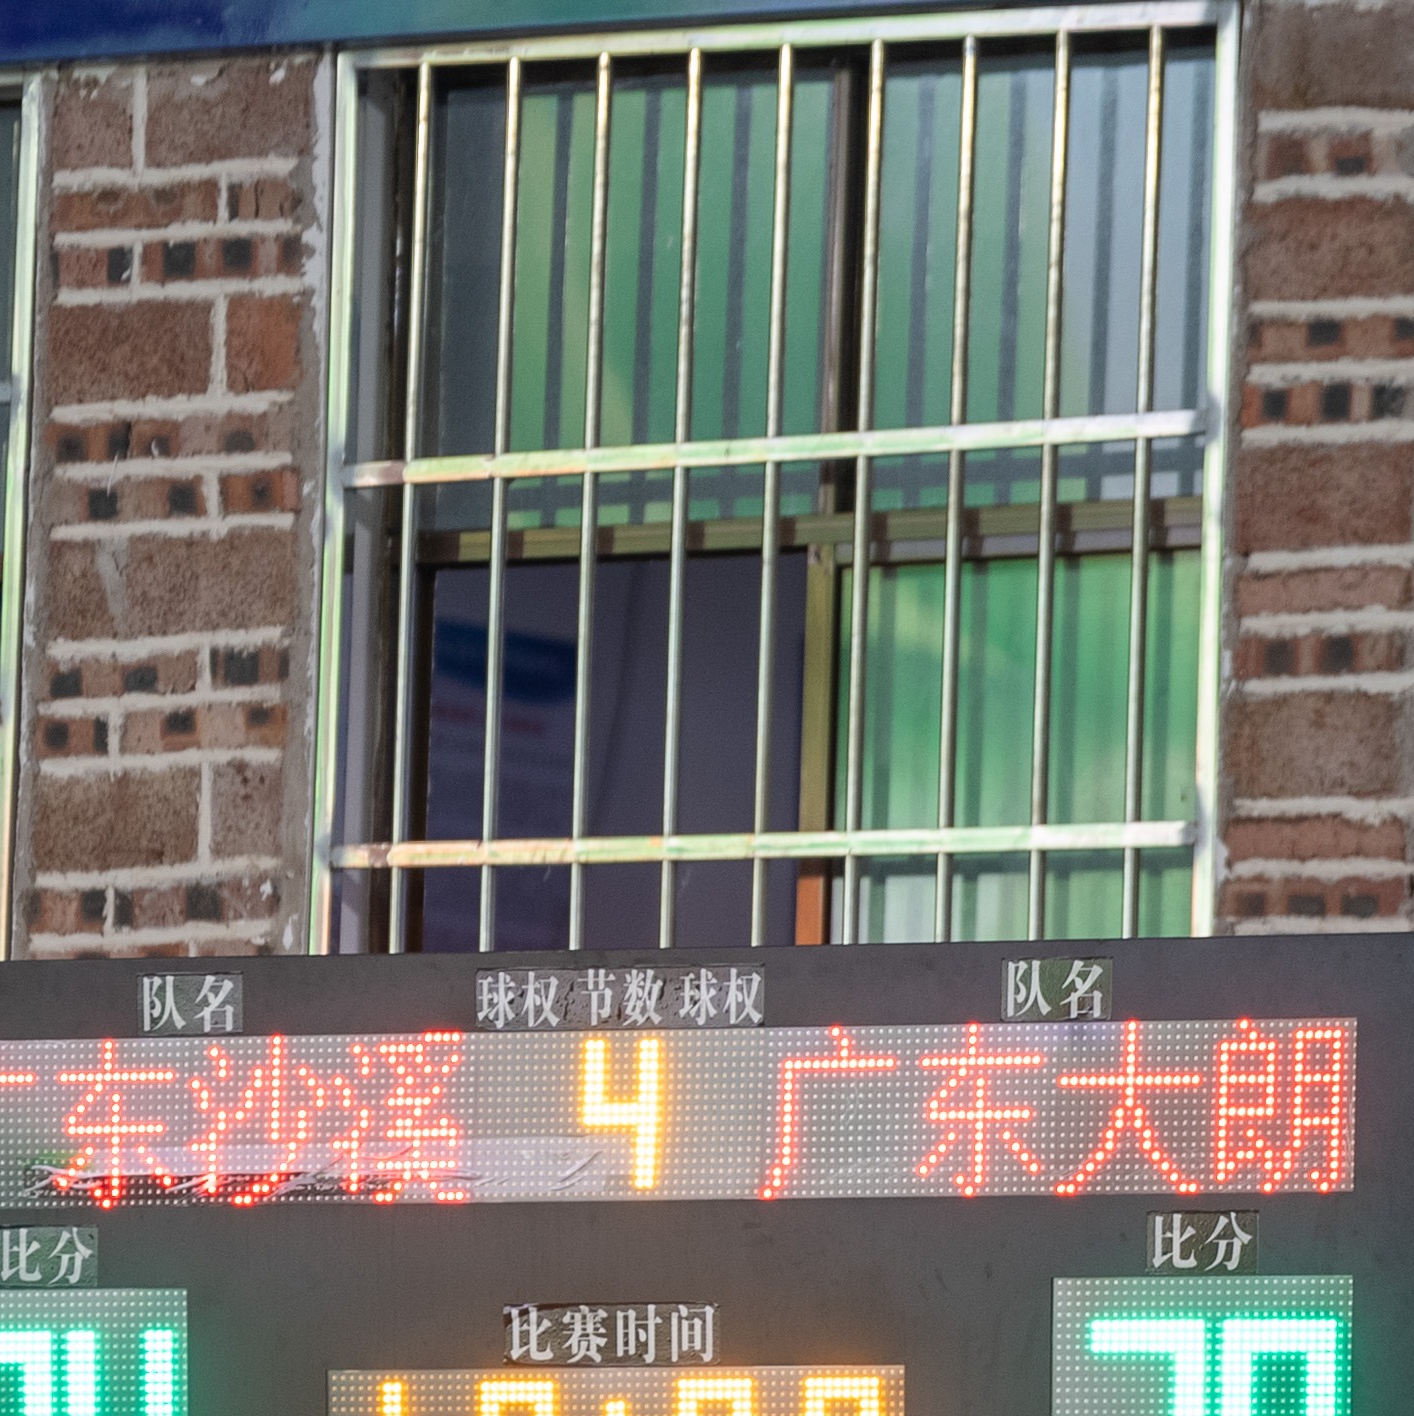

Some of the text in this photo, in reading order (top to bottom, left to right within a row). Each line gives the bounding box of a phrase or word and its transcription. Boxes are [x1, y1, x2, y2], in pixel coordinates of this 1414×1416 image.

[142, 974, 240, 1032] 队名
[477, 967, 762, 1028] 球权 节数 球权
[1005, 960, 1105, 1020] 队名
[584, 1038, 661, 1190] 4
[760, 1019, 1344, 1198] 广东大朗
[0, 1227, 92, 1285] 比分
[1152, 1212, 1254, 1271] 比分
[509, 1304, 716, 1364] 比赛时间
